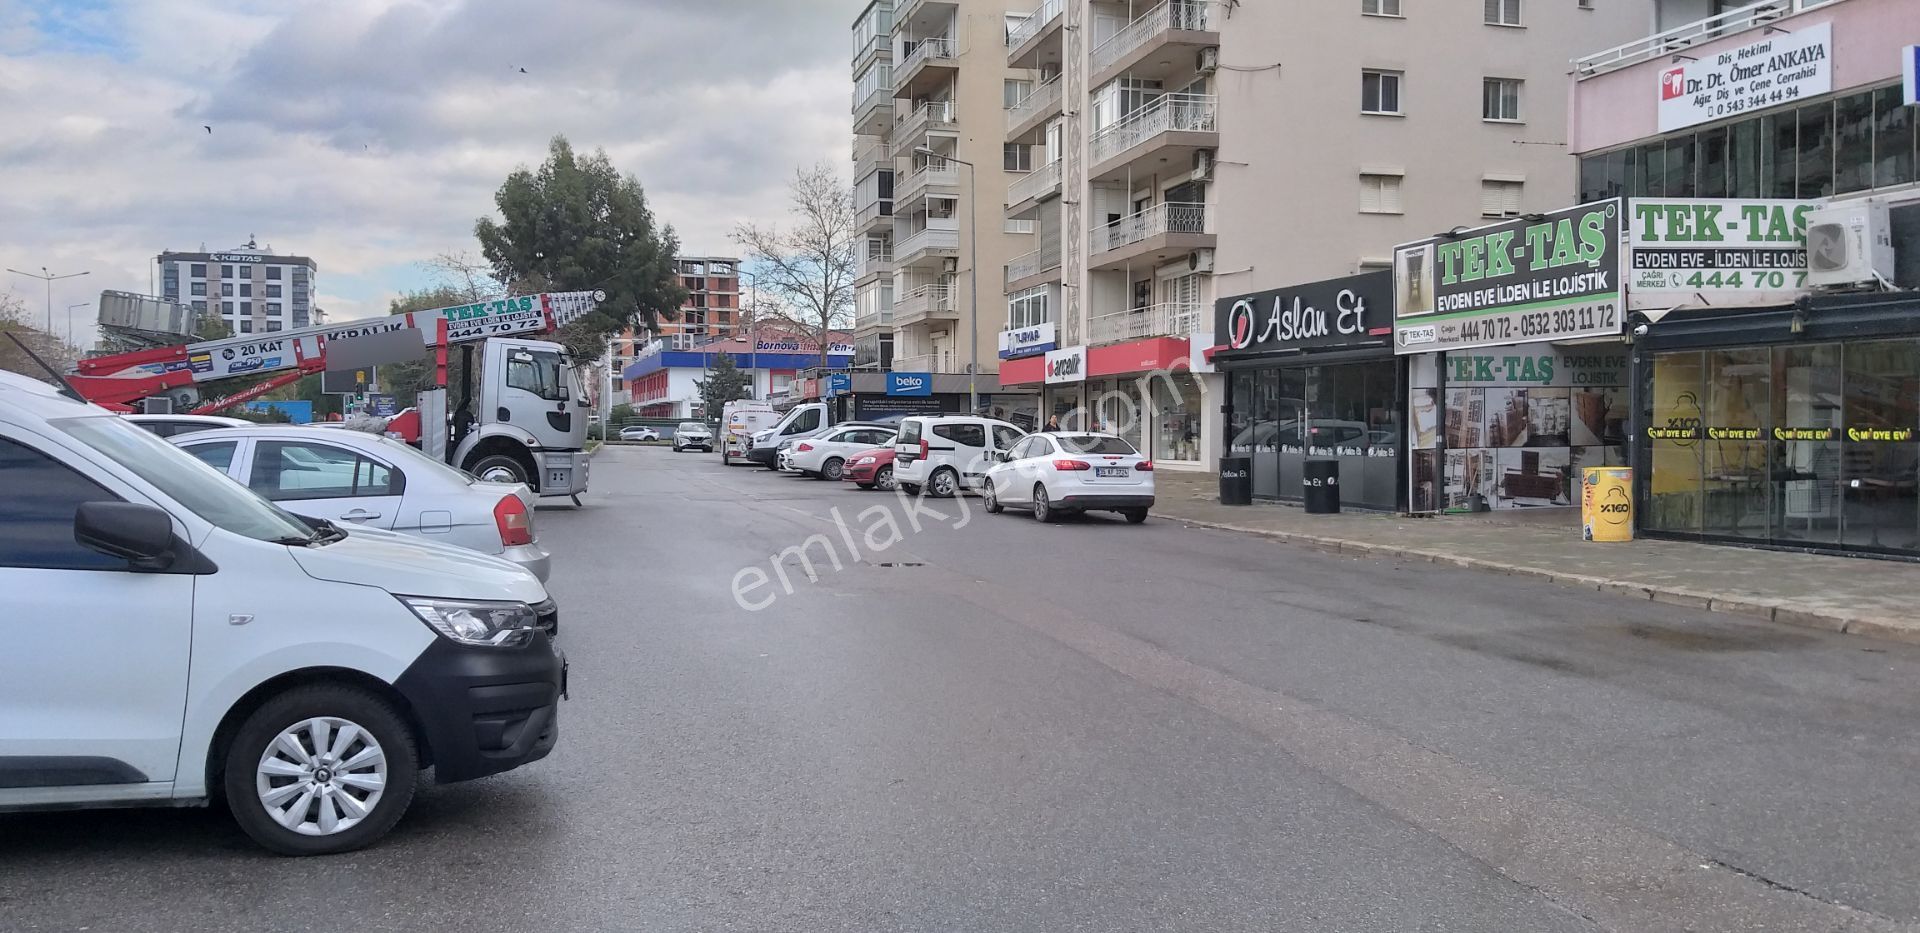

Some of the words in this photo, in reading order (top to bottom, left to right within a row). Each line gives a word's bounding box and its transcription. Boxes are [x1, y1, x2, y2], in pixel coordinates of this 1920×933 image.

[1737, 40, 1772, 60] Hekimi
[1686, 78, 1703, 95] Dr.
[1707, 73, 1725, 90] Dt.
[1730, 62, 1764, 83] Ömer
[1767, 43, 1826, 74] ANKAYA
[1693, 93, 1711, 108] Ağız
[1716, 88, 1730, 102] Diş
[1735, 86, 1744, 96] ve
[1750, 77, 1771, 94] Çene
[1776, 64, 1817, 86] Cerrahisi
[1717, 105, 1723, 115] 0
[1726, 99, 1744, 114] 543
[1747, 94, 1767, 109] 344
[1769, 90, 1783, 104] 44
[1785, 85, 1799, 100] 94
[1437, 210, 1607, 286] TEK-TAŞ
[1635, 252, 1677, 268] EVDEN
[1680, 252, 1704, 268] EVE
[1714, 249, 1749, 268] İLDEN
[1752, 249, 1770, 268] İLE
[1773, 249, 1808, 268] LOJİS
[1637, 279, 1666, 289] MERKEZİ
[1641, 270, 1663, 281] ÇAĞRI
[1686, 271, 1743, 288] 444
[1751, 271, 1784, 288] 70
[1792, 271, 1808, 288] 7
[1438, 292, 1473, 312] EVDEN
[1474, 289, 1495, 308] EVE
[1497, 282, 1531, 304] İLDEN
[1532, 278, 1550, 299] İLE
[1553, 268, 1608, 296] LOJİSTİK
[442, 296, 534, 321] TEK-TAŞ
[1257, 296, 1328, 343] Aslan
[1336, 289, 1365, 335] Et
[449, 320, 469, 330] EVDEN
[470, 318, 481, 328] EVE
[449, 327, 483, 338] 444
[488, 323, 511, 333] 70
[519, 319, 539, 329] 72
[1461, 320, 1479, 342] 444
[1482, 318, 1495, 340] 70
[1498, 317, 1511, 338] 72
[1521, 311, 1550, 337] 0532
[1553, 309, 1575, 332] 303
[1579, 306, 1594, 330] 11
[1598, 304, 1614, 328] 72
[241, 345, 256, 356] 20
[259, 341, 283, 354] KAT
[756, 340, 799, 351] Bornova
[1054, 353, 1080, 381] arçelik
[1564, 356, 1600, 369] EVDEN
[1606, 356, 1626, 368] EVE
[896, 376, 922, 387] beko
[1239, 469, 1247, 478] Et
[1303, 477, 1311, 487] lan
[1312, 477, 1322, 487] Et
